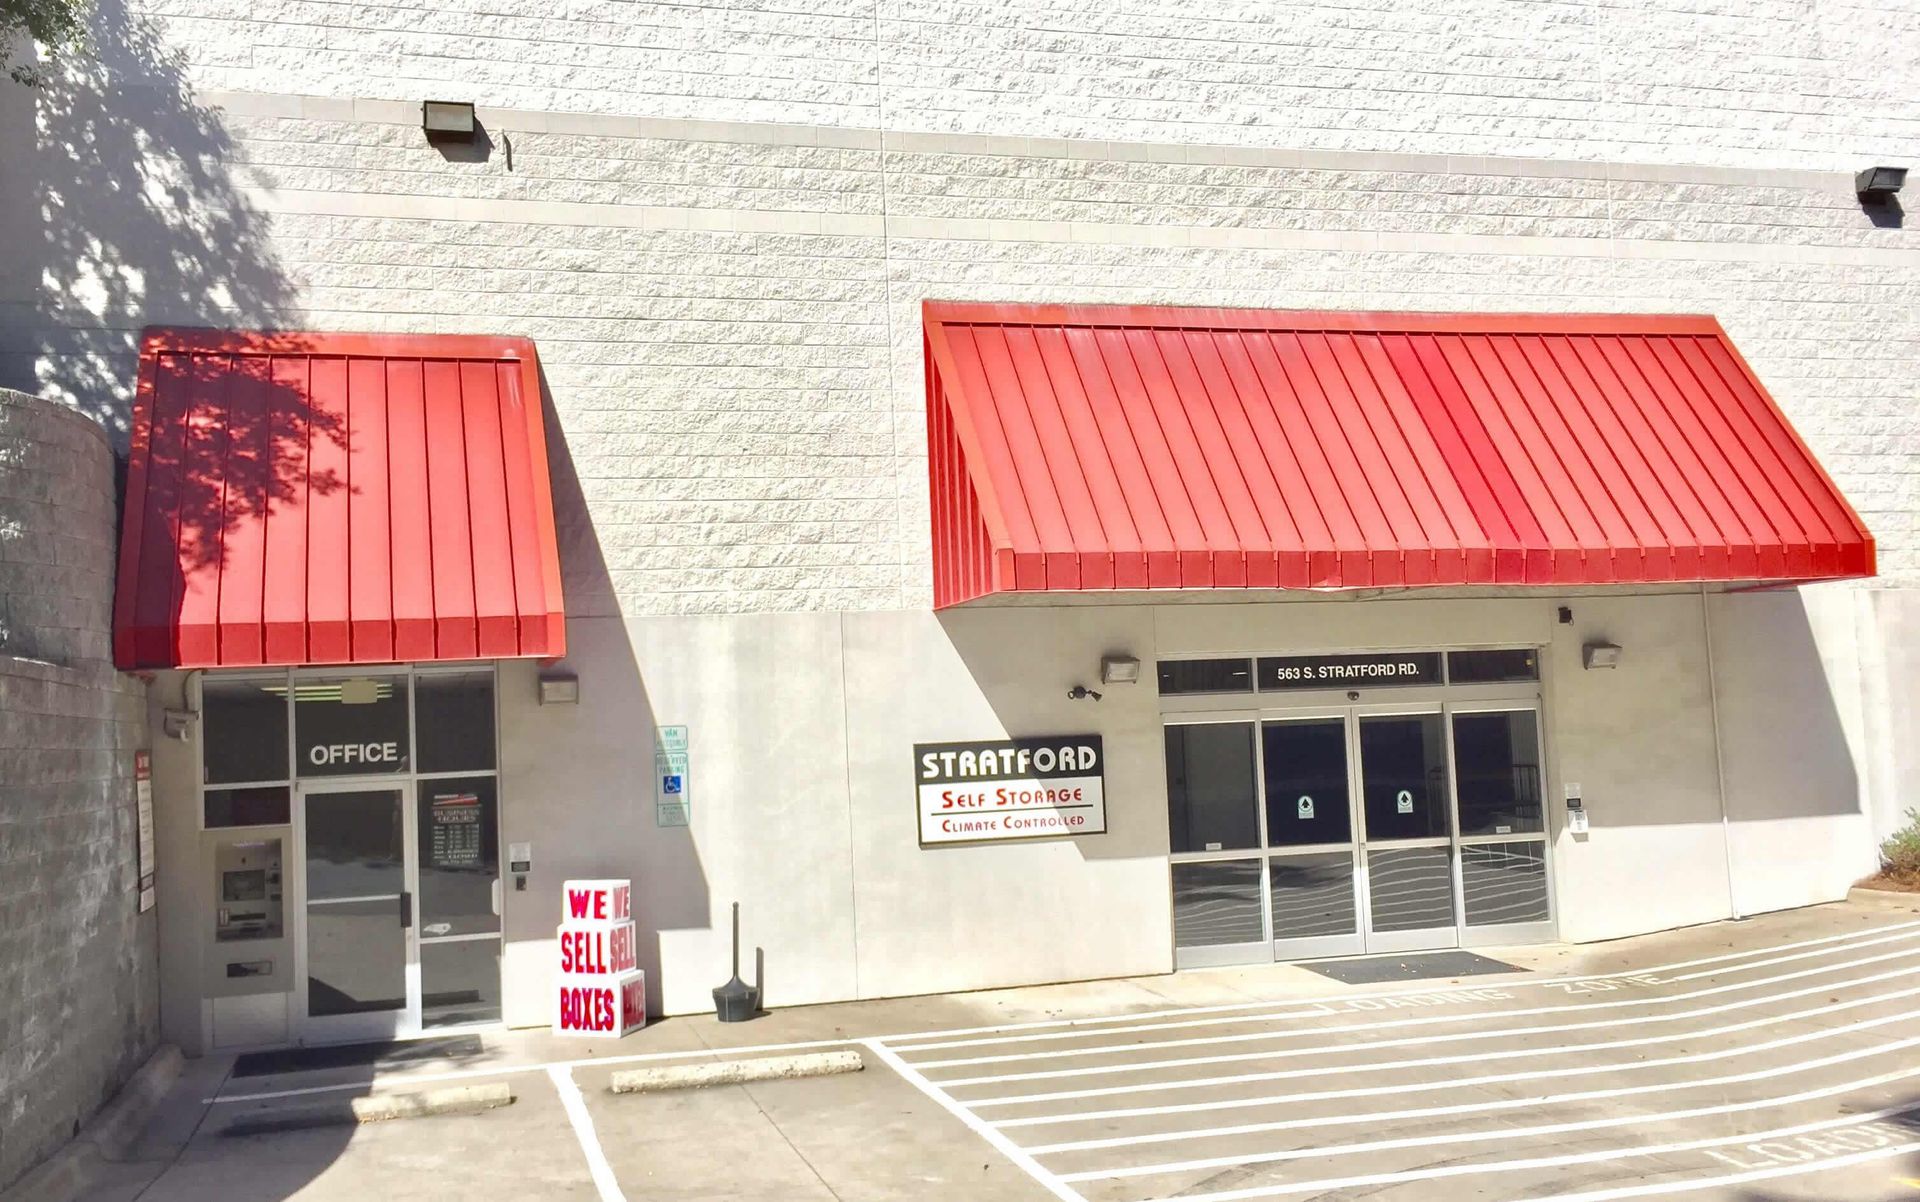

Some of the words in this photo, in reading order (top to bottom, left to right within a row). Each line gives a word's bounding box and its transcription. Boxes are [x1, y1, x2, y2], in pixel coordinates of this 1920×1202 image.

[1277, 667, 1300, 679] 563
[1303, 666, 1316, 679] S.
[1318, 664, 1396, 679] STRATFORD
[1398, 662, 1419, 675] RD.
[310, 742, 398, 765] OFFICE
[921, 745, 1097, 779] STRATFORD
[942, 790, 986, 809] SELF
[996, 788, 1082, 806] STORAGE
[942, 819, 997, 833] CLIMATE
[1003, 815, 1084, 829] CONTROLLED
[568, 889, 608, 920] WE
[613, 886, 630, 920] WE
[561, 931, 608, 974] SELL
[610, 925, 636, 974] SELL
[560, 986, 615, 1031] BOXES
[1312, 988, 1516, 1014] LOADING
